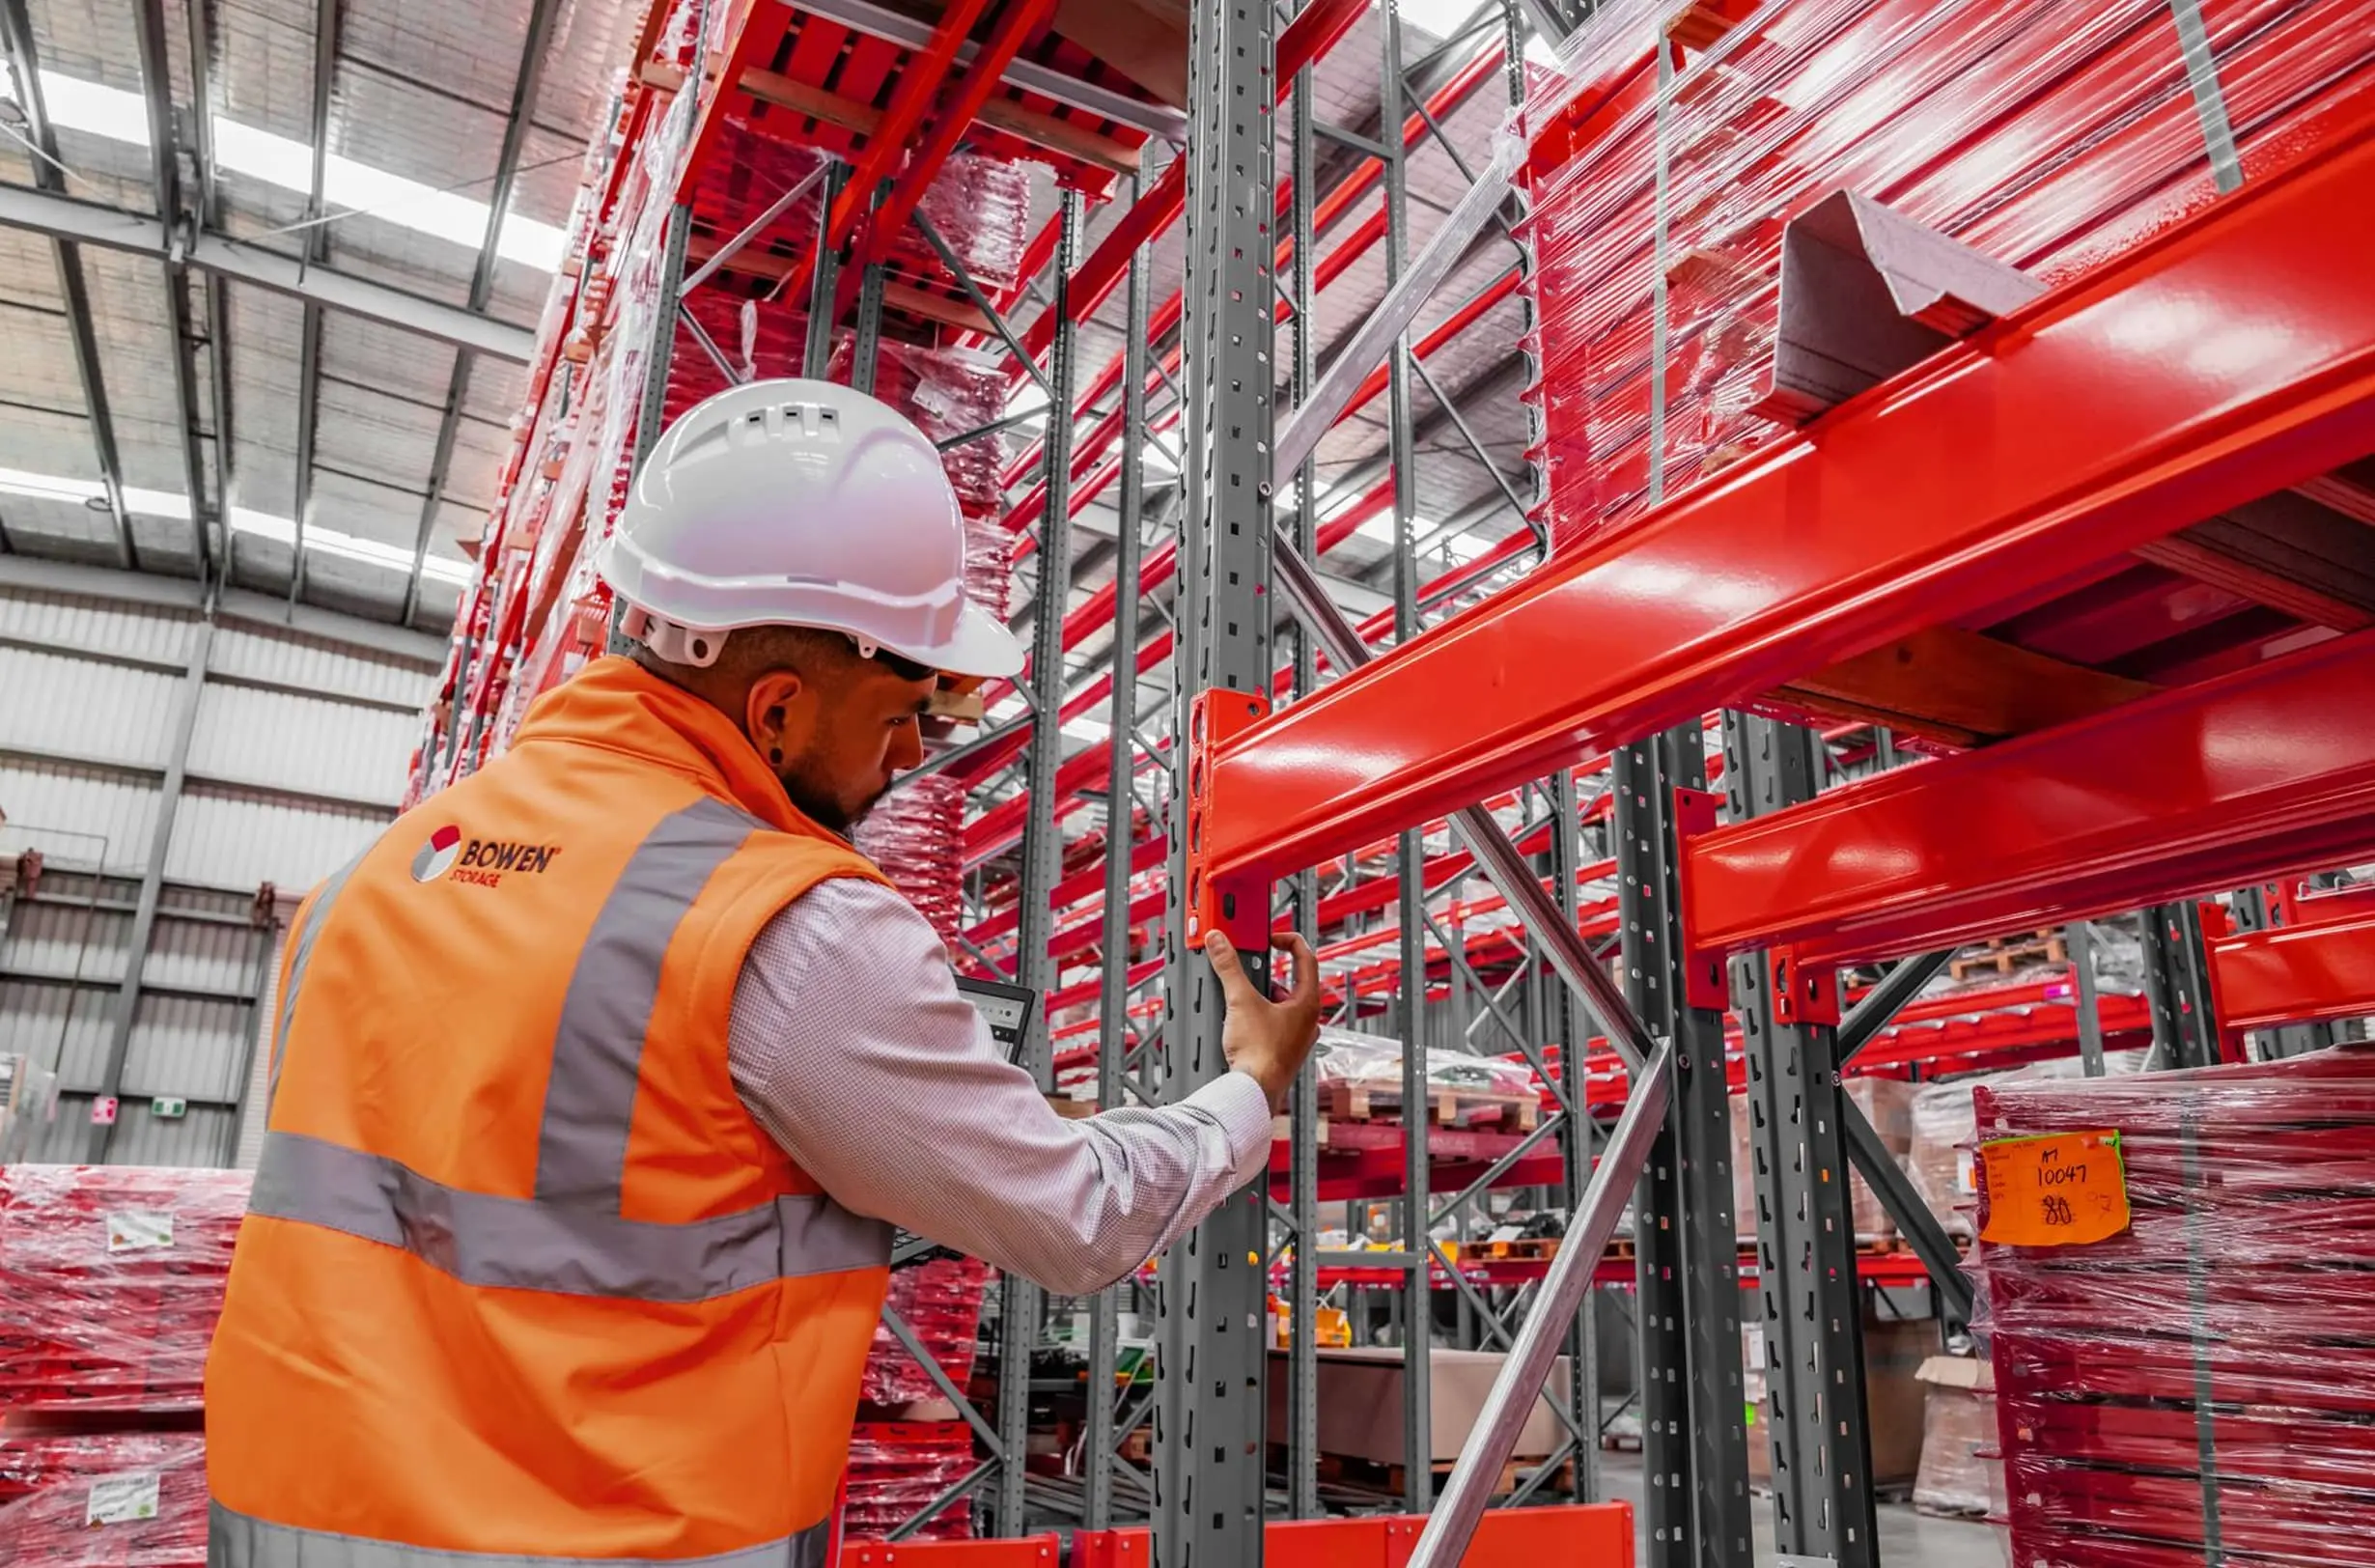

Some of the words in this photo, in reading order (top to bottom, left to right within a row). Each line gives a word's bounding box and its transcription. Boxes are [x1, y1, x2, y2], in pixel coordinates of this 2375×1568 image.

[460, 839, 556, 873] BOWEN
[449, 869, 501, 888] STORAGE
[2037, 1164, 2087, 1187] 10047
[2042, 1193, 2073, 1225] 80
